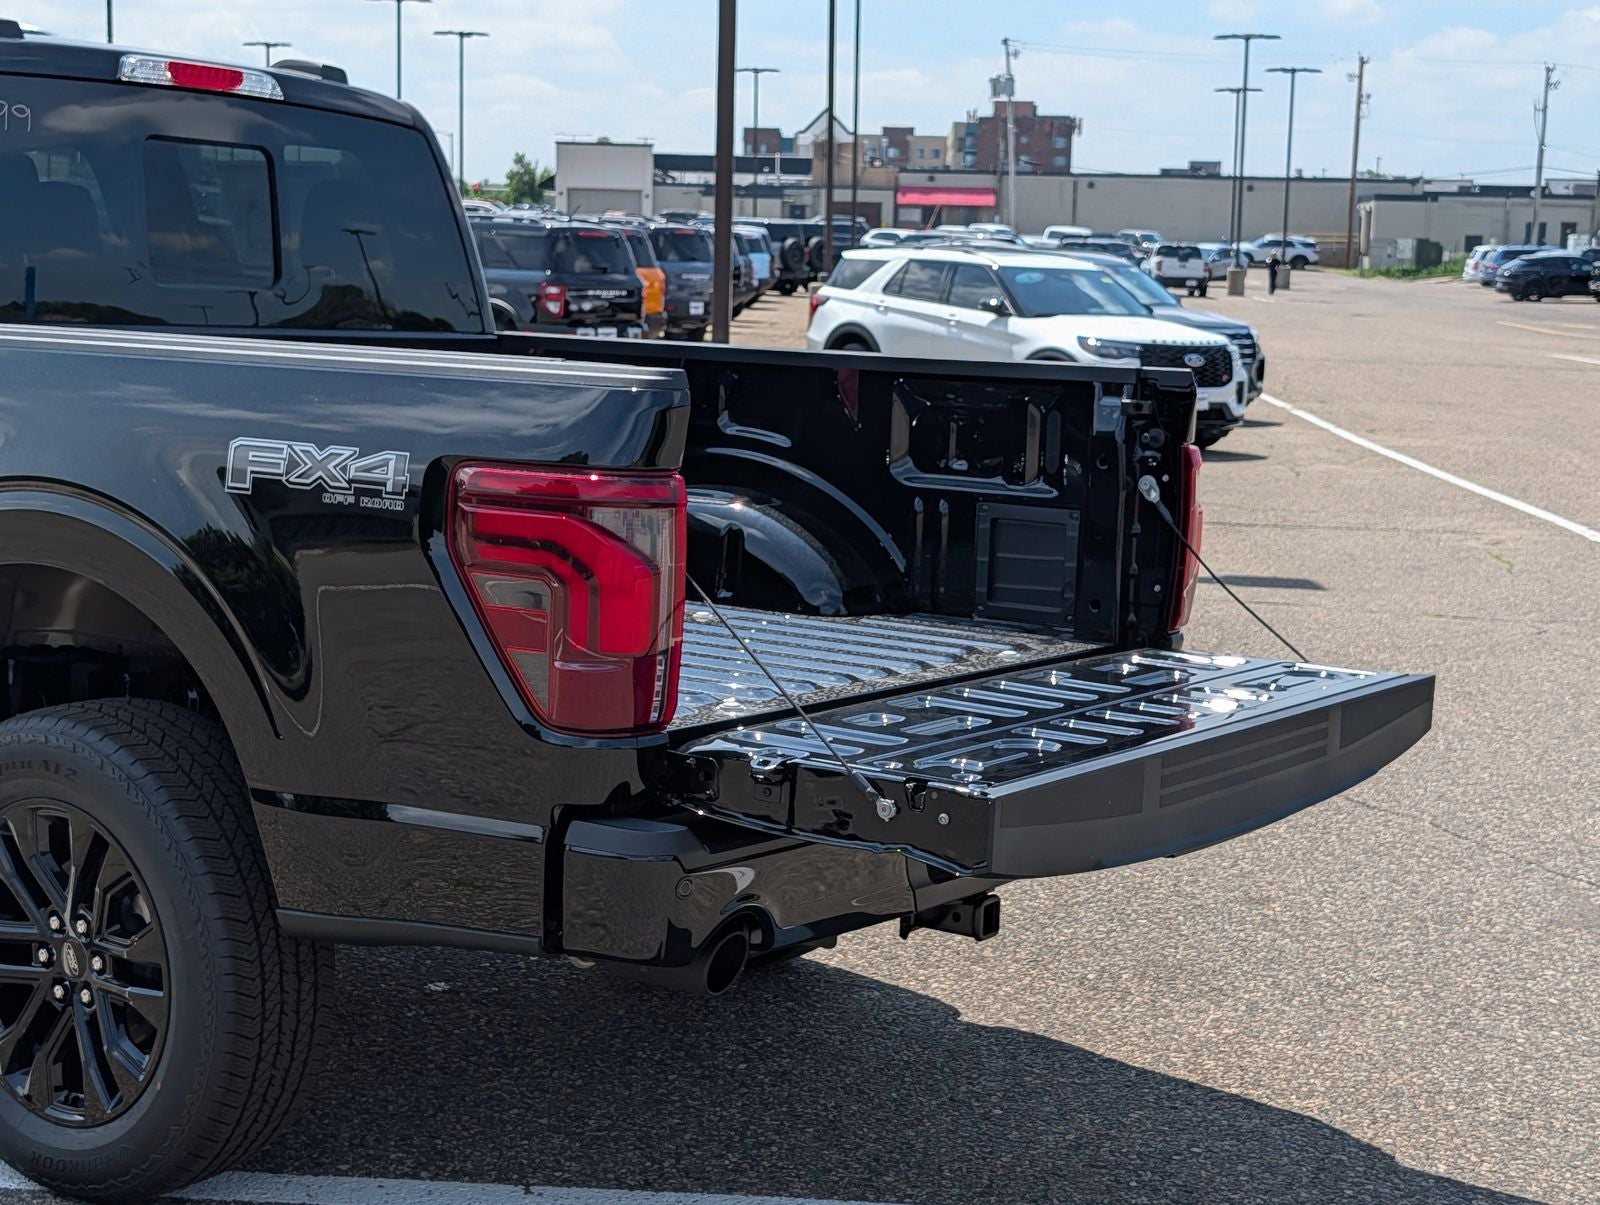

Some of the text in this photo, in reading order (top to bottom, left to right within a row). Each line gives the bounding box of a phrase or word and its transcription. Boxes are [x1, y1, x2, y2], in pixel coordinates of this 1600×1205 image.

[225, 437, 410, 499] FX4
[322, 493, 405, 511] OFF ROAD
